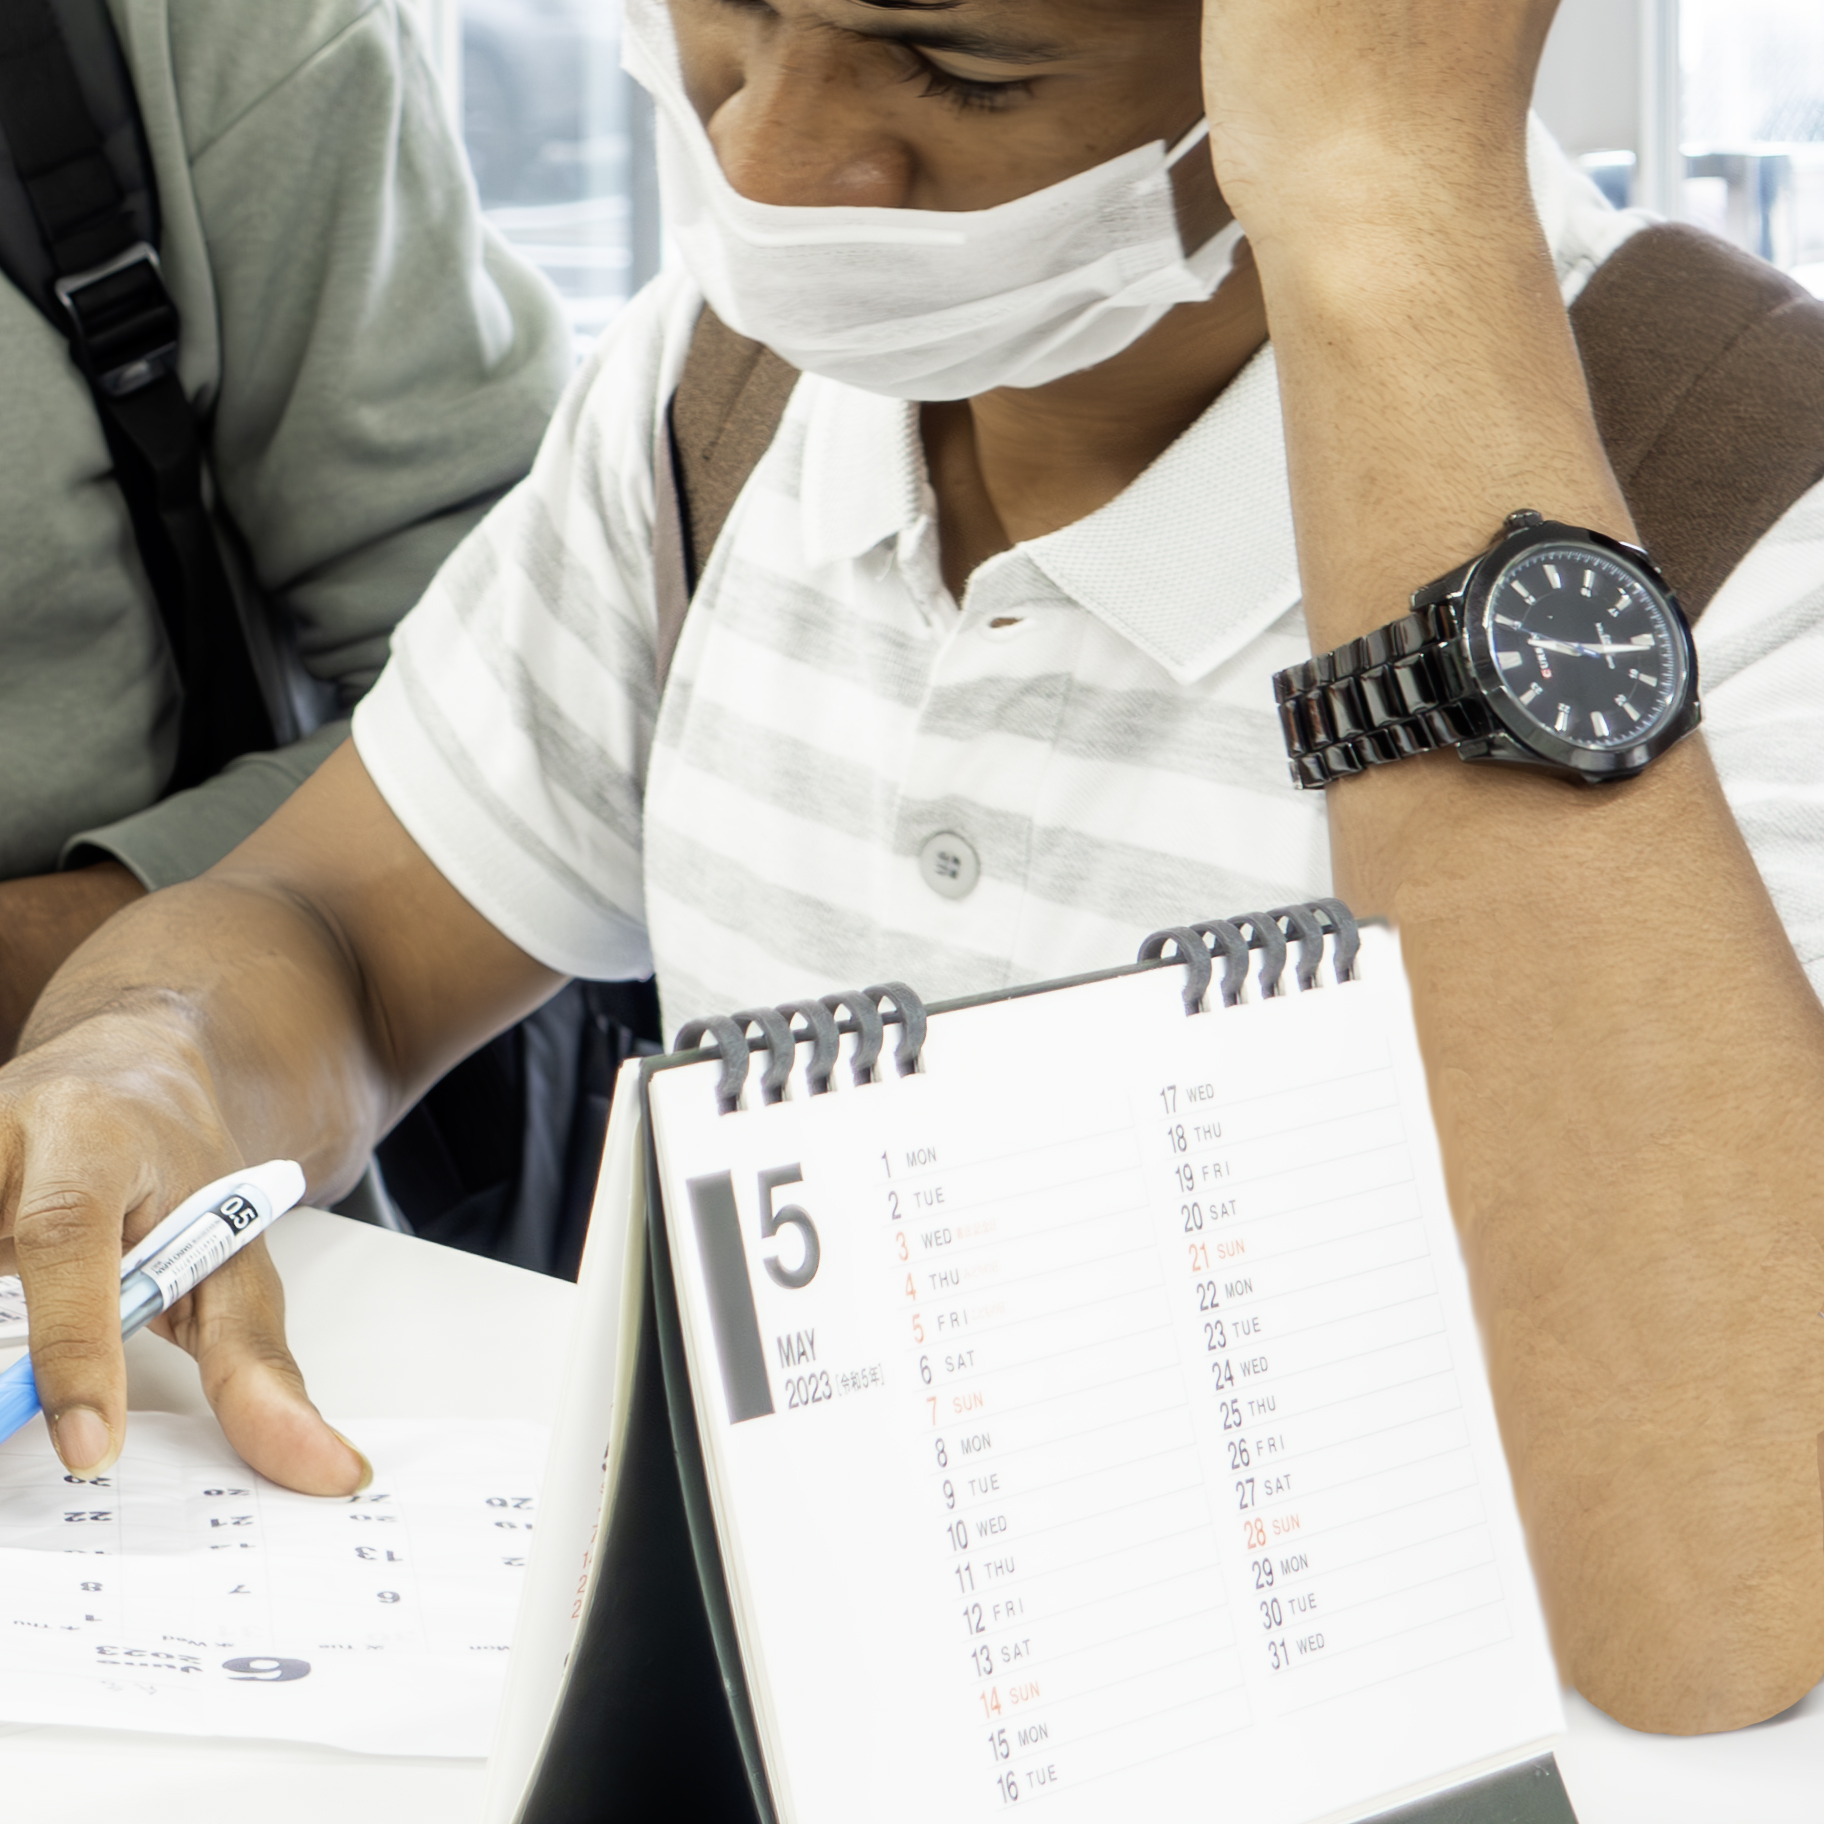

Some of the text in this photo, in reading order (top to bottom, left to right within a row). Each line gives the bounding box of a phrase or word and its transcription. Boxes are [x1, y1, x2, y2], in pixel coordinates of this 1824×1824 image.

[1160, 1084, 1214, 1114] 17 WED
[1168, 1122, 1221, 1153] 18 THU
[881, 1147, 936, 1178] 1 MON
[1175, 1162, 1229, 1192] 19 FRI
[220, 1196, 256, 1230] 0.5
[888, 1187, 945, 1220] 2 TUE
[1181, 1200, 1236, 1233] 20 SAT
[757, 1161, 821, 1291] 5
[896, 1232, 909, 1261] 3
[922, 1228, 952, 1248] WED
[1189, 1240, 1245, 1272] 21 SUN
[906, 1273, 917, 1301] 4
[929, 1269, 959, 1289] THU
[1196, 1278, 1253, 1312] 22 MON
[912, 1313, 925, 1343] 5
[938, 1310, 967, 1331] FRI
[1204, 1317, 1261, 1351] 23 TUE
[776, 1328, 816, 1369] MAY
[920, 1350, 974, 1385] 6 SAT
[1212, 1356, 1268, 1391] 24 WED
[785, 1370, 832, 1410] 2023
[927, 1392, 983, 1425] 7 SUN
[1220, 1396, 1276, 1430] 25 THU
[935, 1434, 991, 1468] 8 MON
[1228, 1435, 1284, 1470] 26 FRI
[943, 1474, 999, 1510] 9 TUE
[1235, 1474, 1290, 1510] 27 SAT
[63, 1511, 112, 1523] 22
[209, 1514, 254, 1528] 21
[947, 1515, 1007, 1551] 10 WED
[1244, 1514, 1300, 1550] 28 SUN
[353, 1545, 404, 1563] 13
[80, 1581, 103, 1592] 8
[228, 1583, 252, 1595] 7
[955, 1557, 1015, 1593] 11 THU
[1252, 1554, 1308, 1590] 29 MON
[375, 1590, 401, 1604] 6
[1260, 1593, 1317, 1630] 30 TUE
[963, 1599, 1023, 1635] 12 FRI
[971, 1639, 1030, 1677] 13 SAT
[1268, 1633, 1324, 1670] 31 WED
[222, 1656, 312, 1682] 6
[980, 1682, 1040, 1718] 14 SUN
[988, 1723, 1048, 1761] 15 MON
[997, 1764, 1057, 1803] 16 TUE
